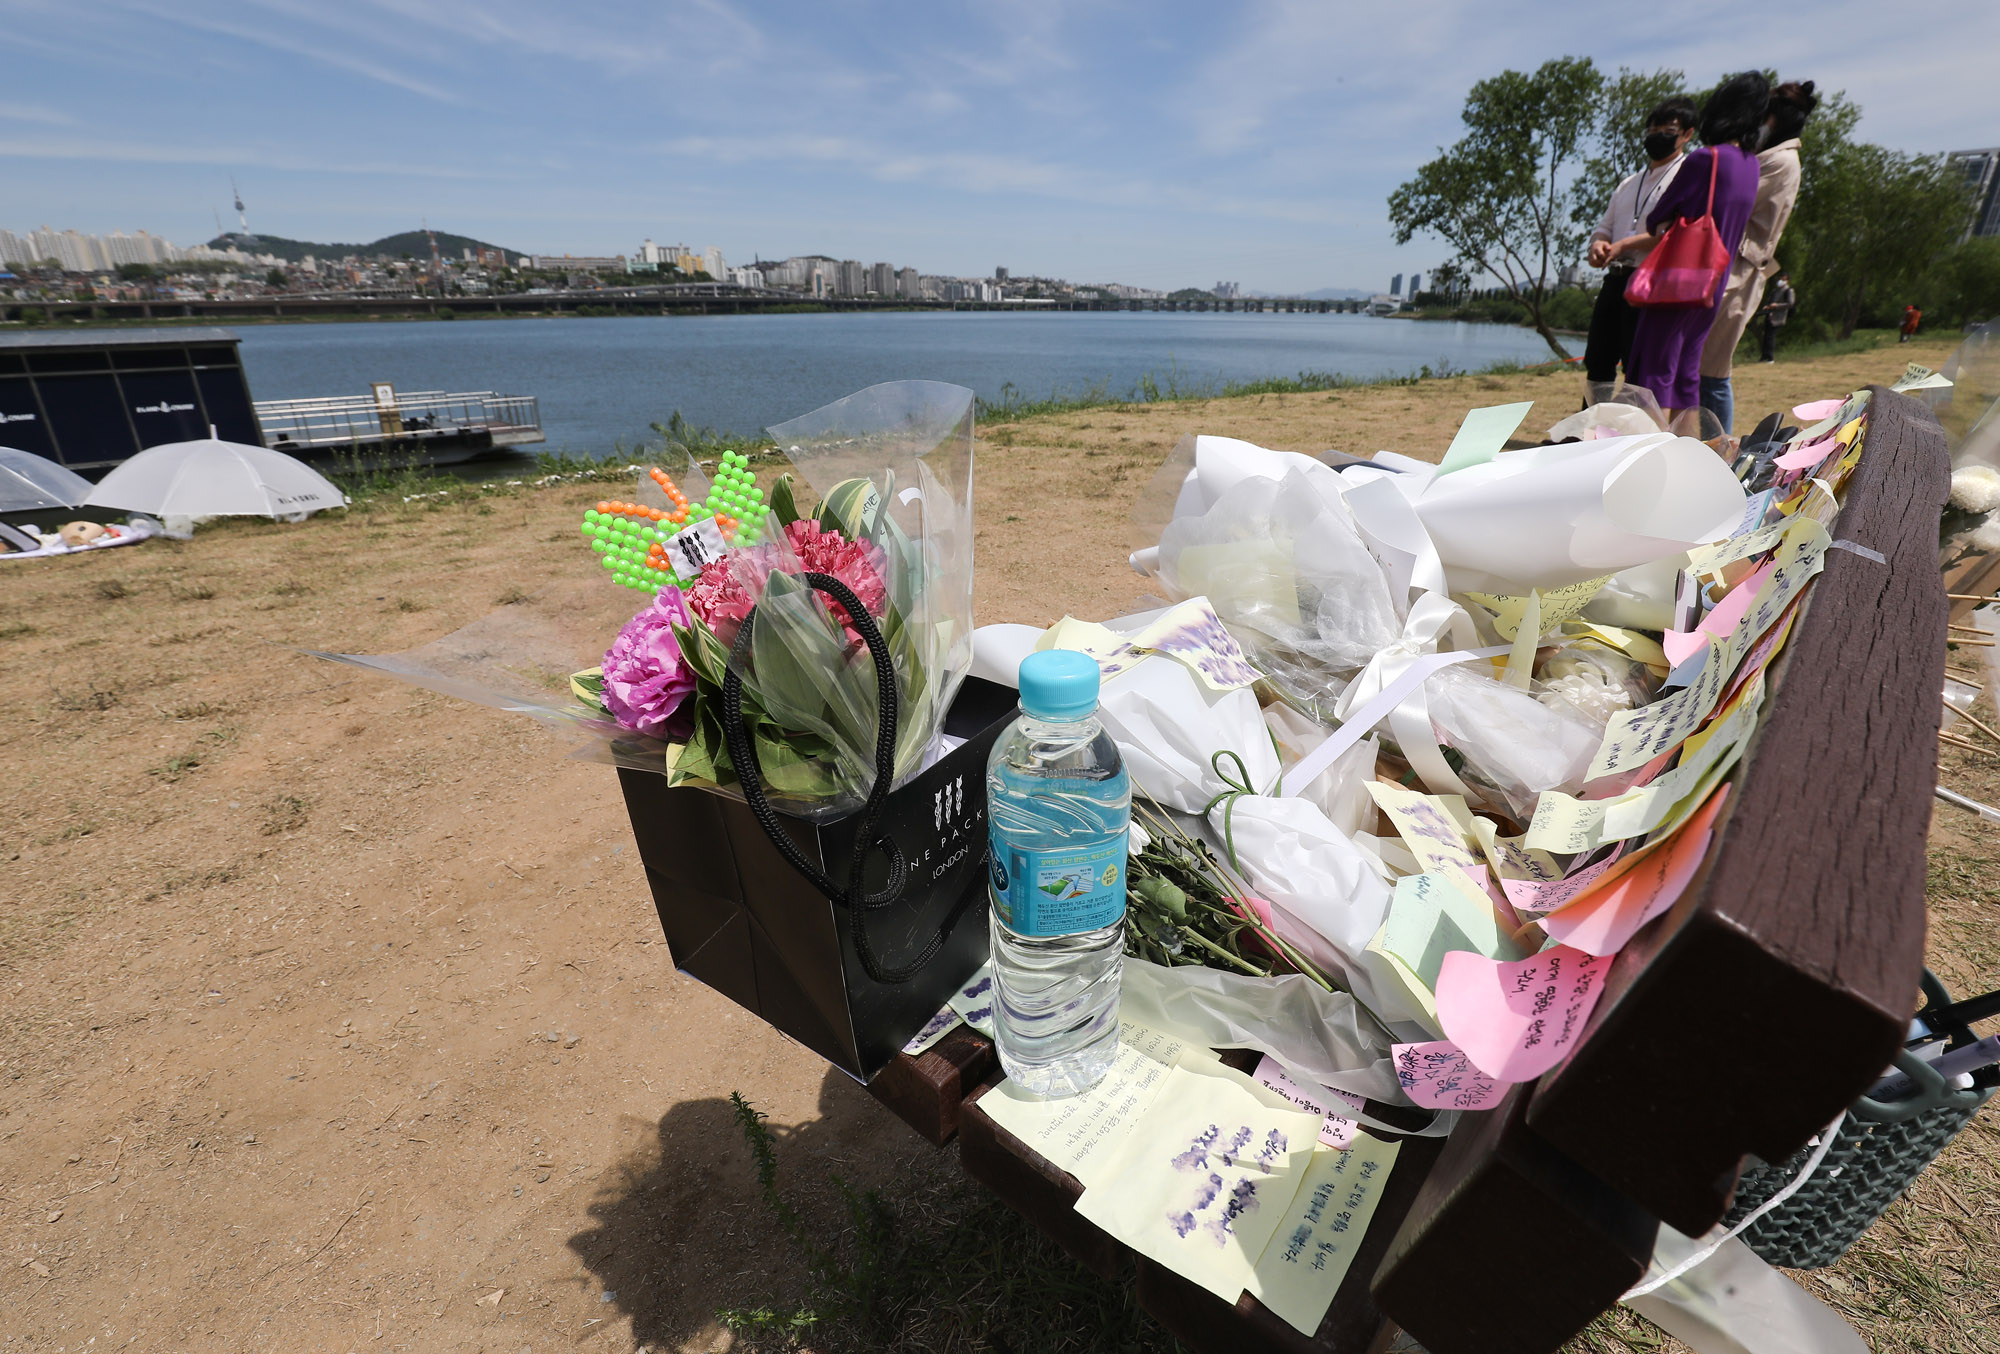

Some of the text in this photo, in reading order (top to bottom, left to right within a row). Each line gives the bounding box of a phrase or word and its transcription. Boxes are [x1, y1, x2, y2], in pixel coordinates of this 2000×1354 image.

[941, 809, 984, 849] PACK
[932, 845, 969, 880] LONDON
[1295, 1098, 1320, 1114] 마음이
